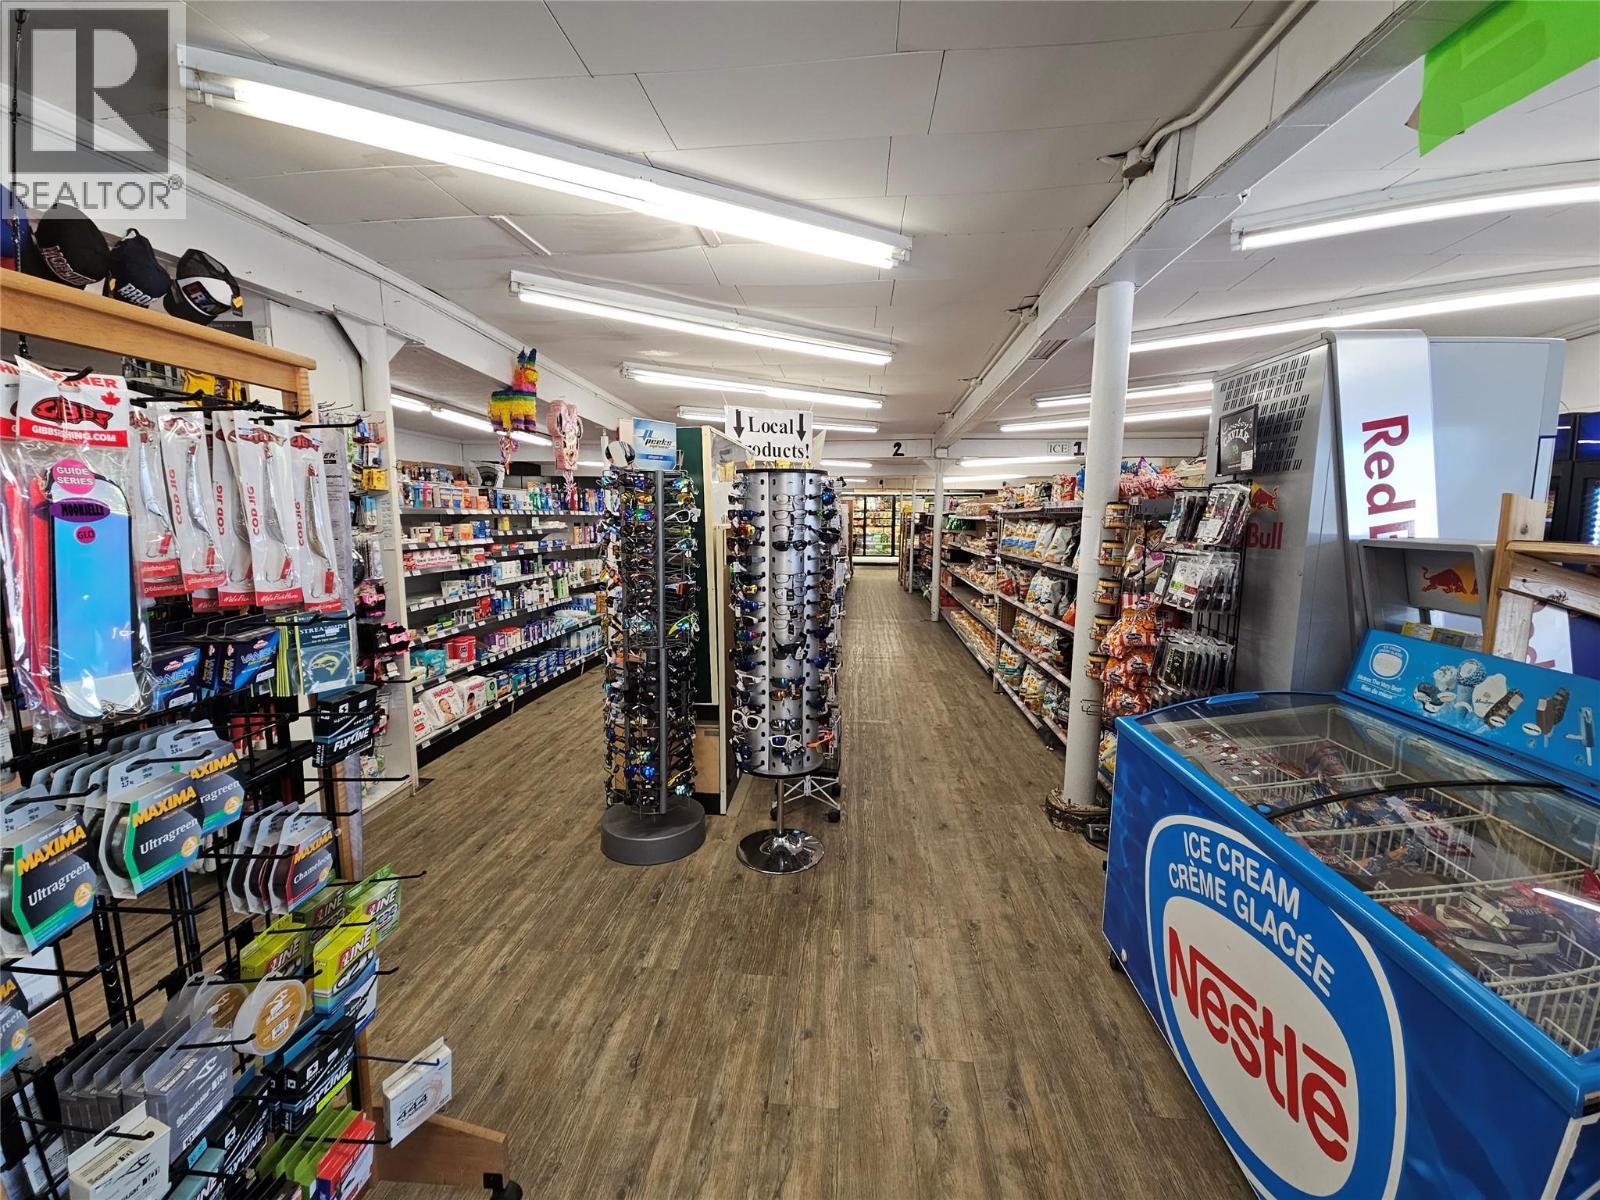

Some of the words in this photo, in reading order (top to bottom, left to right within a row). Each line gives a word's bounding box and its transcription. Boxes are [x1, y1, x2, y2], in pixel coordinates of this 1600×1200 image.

[749, 416, 794, 435] Local
[745, 443, 810, 460] roducts!
[893, 442, 905, 457] 2
[1050, 444, 1068, 454] ICE
[1073, 441, 1085, 457] 1
[56, 466, 89, 475] GUIDE
[1361, 415, 1417, 516] Red
[57, 476, 94, 486] SERIES
[76, 530, 95, 540] GLO
[189, 752, 239, 780] AXIMA
[200, 780, 241, 804] ragreen
[131, 786, 198, 828] MAXIMA
[140, 817, 199, 855] Ultragreen
[17, 825, 87, 876] MAXIMA
[27, 862, 91, 907] Ultragreen
[1183, 831, 1213, 864] ICE
[1216, 842, 1301, 920] CREAM
[1168, 861, 1228, 909] CRÈME
[1233, 893, 1336, 998] GLACÉE
